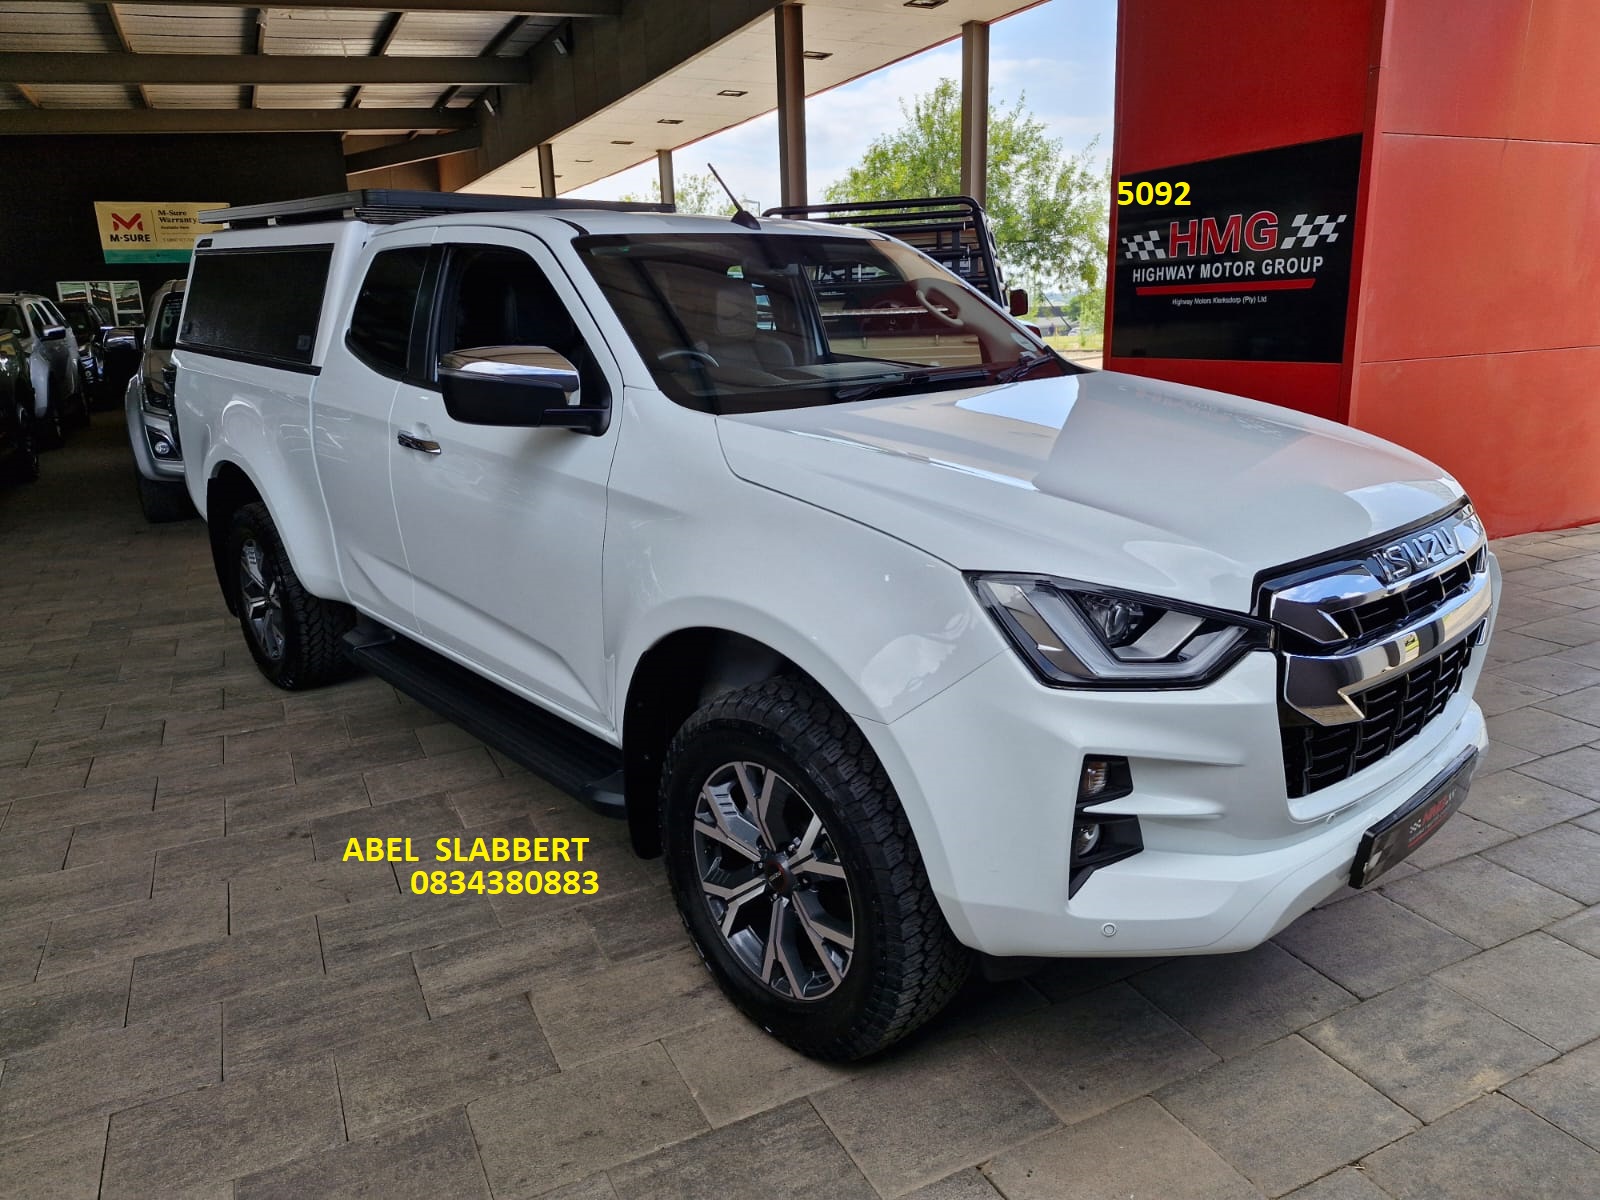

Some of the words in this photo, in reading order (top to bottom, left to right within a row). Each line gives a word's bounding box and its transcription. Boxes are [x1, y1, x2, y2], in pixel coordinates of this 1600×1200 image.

[1168, 211, 1279, 258] HMG
[1132, 264, 1195, 283] HIGHWAY
[1199, 260, 1255, 279] MOTOR
[1262, 256, 1324, 276] GROUP
[1372, 526, 1461, 581] ISUZU
